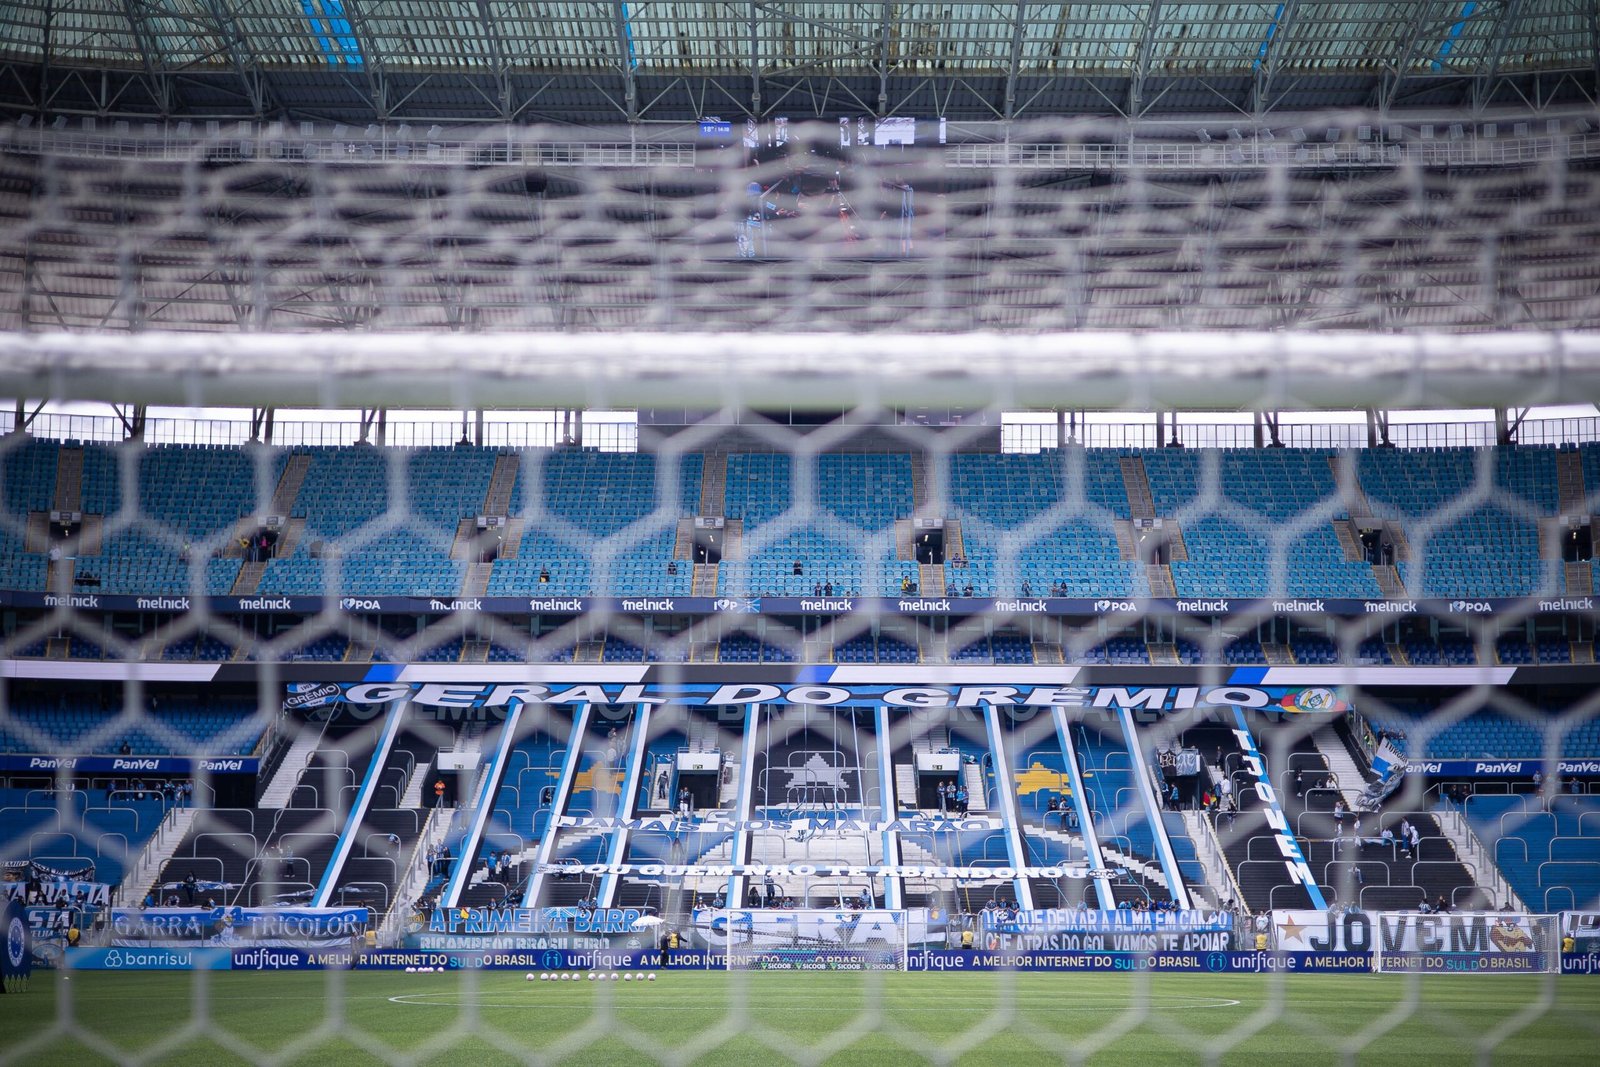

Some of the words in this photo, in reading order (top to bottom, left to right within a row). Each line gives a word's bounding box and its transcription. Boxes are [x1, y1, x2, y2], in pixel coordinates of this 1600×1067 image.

[44, 594, 98, 608] melnick
[137, 597, 190, 609] melnick
[239, 597, 291, 610] melnick
[355, 600, 381, 610] POA
[530, 598, 582, 611] melnick
[622, 598, 674, 611] melnick
[800, 598, 852, 611] melnick
[898, 598, 950, 611] melnick
[995, 600, 1047, 612] melnick
[1112, 601, 1137, 612] POA
[1176, 599, 1229, 612] melnick
[1272, 599, 1325, 612] melnick
[1365, 600, 1417, 613] melnick
[1466, 602, 1492, 613] POA
[1538, 597, 1593, 611] melnick
[346, 683, 669, 708] GERAL
[706, 683, 851, 706] DO
[30, 757, 78, 769] PanVel
[113, 759, 160, 770] PanVel
[198, 760, 243, 771] PanVel
[1405, 762, 1443, 774] anVel
[1475, 762, 1522, 774] PanVel
[638, 864, 738, 876] QUEM
[114, 915, 200, 937] GARRA
[250, 913, 358, 937] TRICOLOR
[429, 908, 446, 932] A
[1016, 909, 1044, 932] QUE
[1101, 909, 1110, 931] A
[1113, 909, 1153, 932] ALMA
[1155, 909, 1177, 931] EM
[1309, 910, 1488, 951] JOVEM
[1062, 934, 1080, 950] DO
[1113, 934, 1158, 951] VAMOS
[1160, 934, 1179, 951] TE
[1183, 932, 1230, 951] APOIAR
[125, 951, 192, 965] banrisul
[234, 949, 299, 970] unifique
[307, 954, 316, 965] A
[318, 954, 368, 965] MELHR
[370, 954, 428, 965] INTERNET
[430, 954, 448, 966] DO
[494, 954, 536, 966] BRASIL
[567, 949, 632, 971] unifique
[640, 955, 649, 966] A
[651, 955, 700, 966] MLHOR
[972, 956, 981, 967] A
[983, 956, 1033, 967] MELHOR
[1035, 956, 1092, 967] INTERNET
[1094, 956, 1112, 967] DO
[1159, 956, 1201, 967] BRASIL
[1232, 951, 1297, 973] unifique
[1304, 957, 1313, 968] A
[1315, 957, 1365, 968] MELHOR
[1367, 957, 1425, 968] ITERNET
[1426, 957, 1444, 968] DO
[1490, 957, 1532, 969] BRASIL
[1563, 953, 1600, 974] unifi
